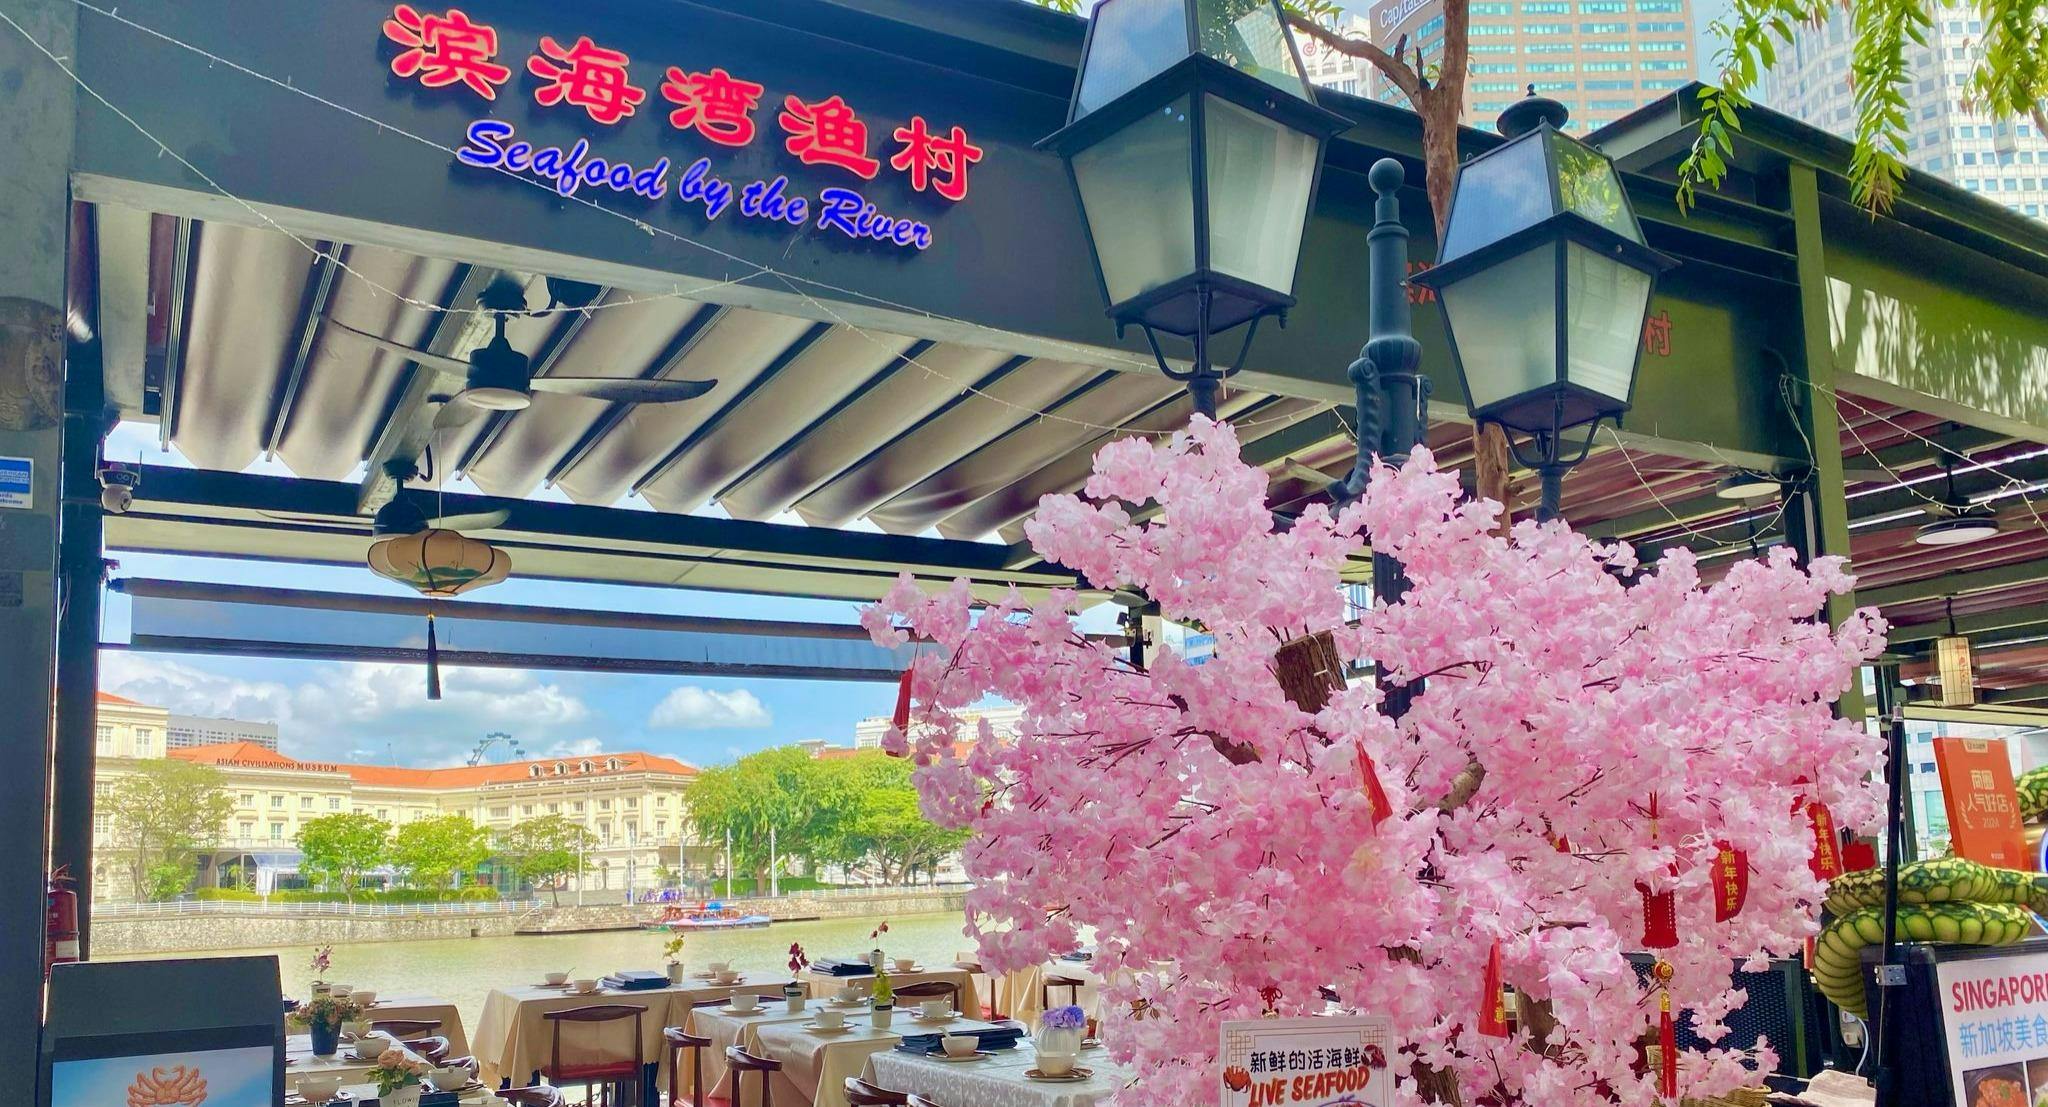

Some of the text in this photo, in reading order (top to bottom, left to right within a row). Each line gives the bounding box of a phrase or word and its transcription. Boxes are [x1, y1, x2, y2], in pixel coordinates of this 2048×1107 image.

[383, 4, 984, 202] 滨海湾渔村
[456, 120, 934, 251] Seafood by the River
[216, 758, 338, 773] ASIAN CIVILISATIONS MUSEUM
[1967, 793, 2009, 812] 人气好店
[1720, 850, 1738, 911] 新年快乐
[1958, 1013, 2048, 1058] 新加坡美食
[1250, 1046, 1361, 1073] 新鲜的活海鲜
[1249, 1065, 1371, 1107] LIVE SEAFOOD
